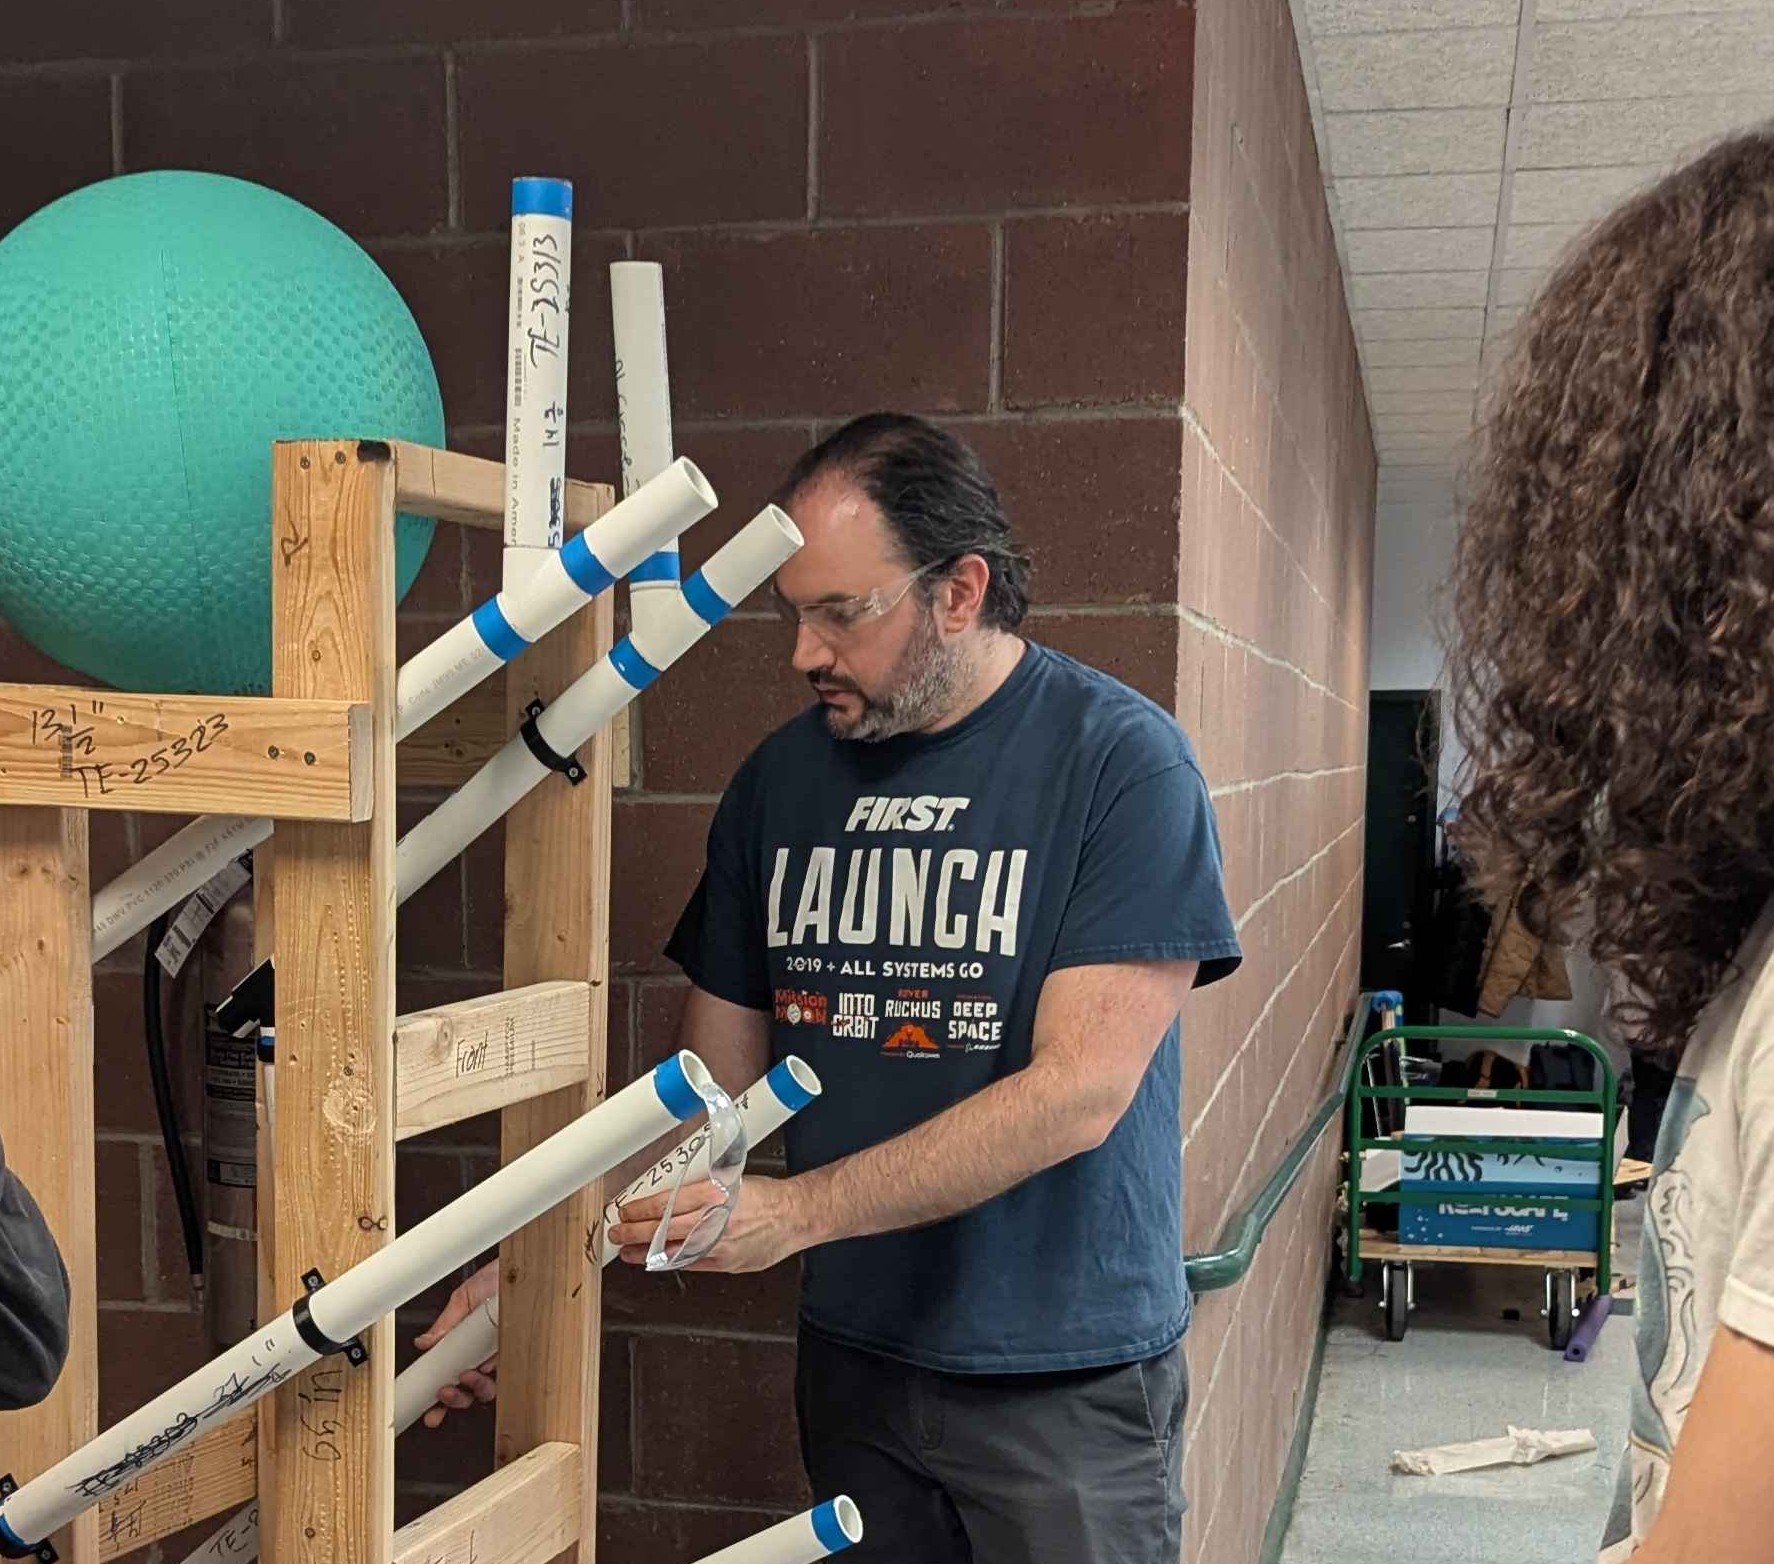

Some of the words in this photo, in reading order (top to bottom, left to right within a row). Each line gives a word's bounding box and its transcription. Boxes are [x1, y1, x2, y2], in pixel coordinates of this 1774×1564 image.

[71, 713, 229, 798] TE-25323
[844, 796, 970, 832] FIRST
[767, 846, 1028, 957] LAUNCH
[787, 957, 822, 972] 2019
[840, 961, 876, 976] ALL
[882, 961, 954, 978] SYSTEMS
[959, 962, 984, 978] GO
[838, 992, 876, 1016] INTO
[884, 1000, 941, 1018] RUCKUS
[952, 1001, 998, 1018] DEEP
[947, 1020, 1003, 1041] SPACE
[456, 1029, 488, 1078] Front
